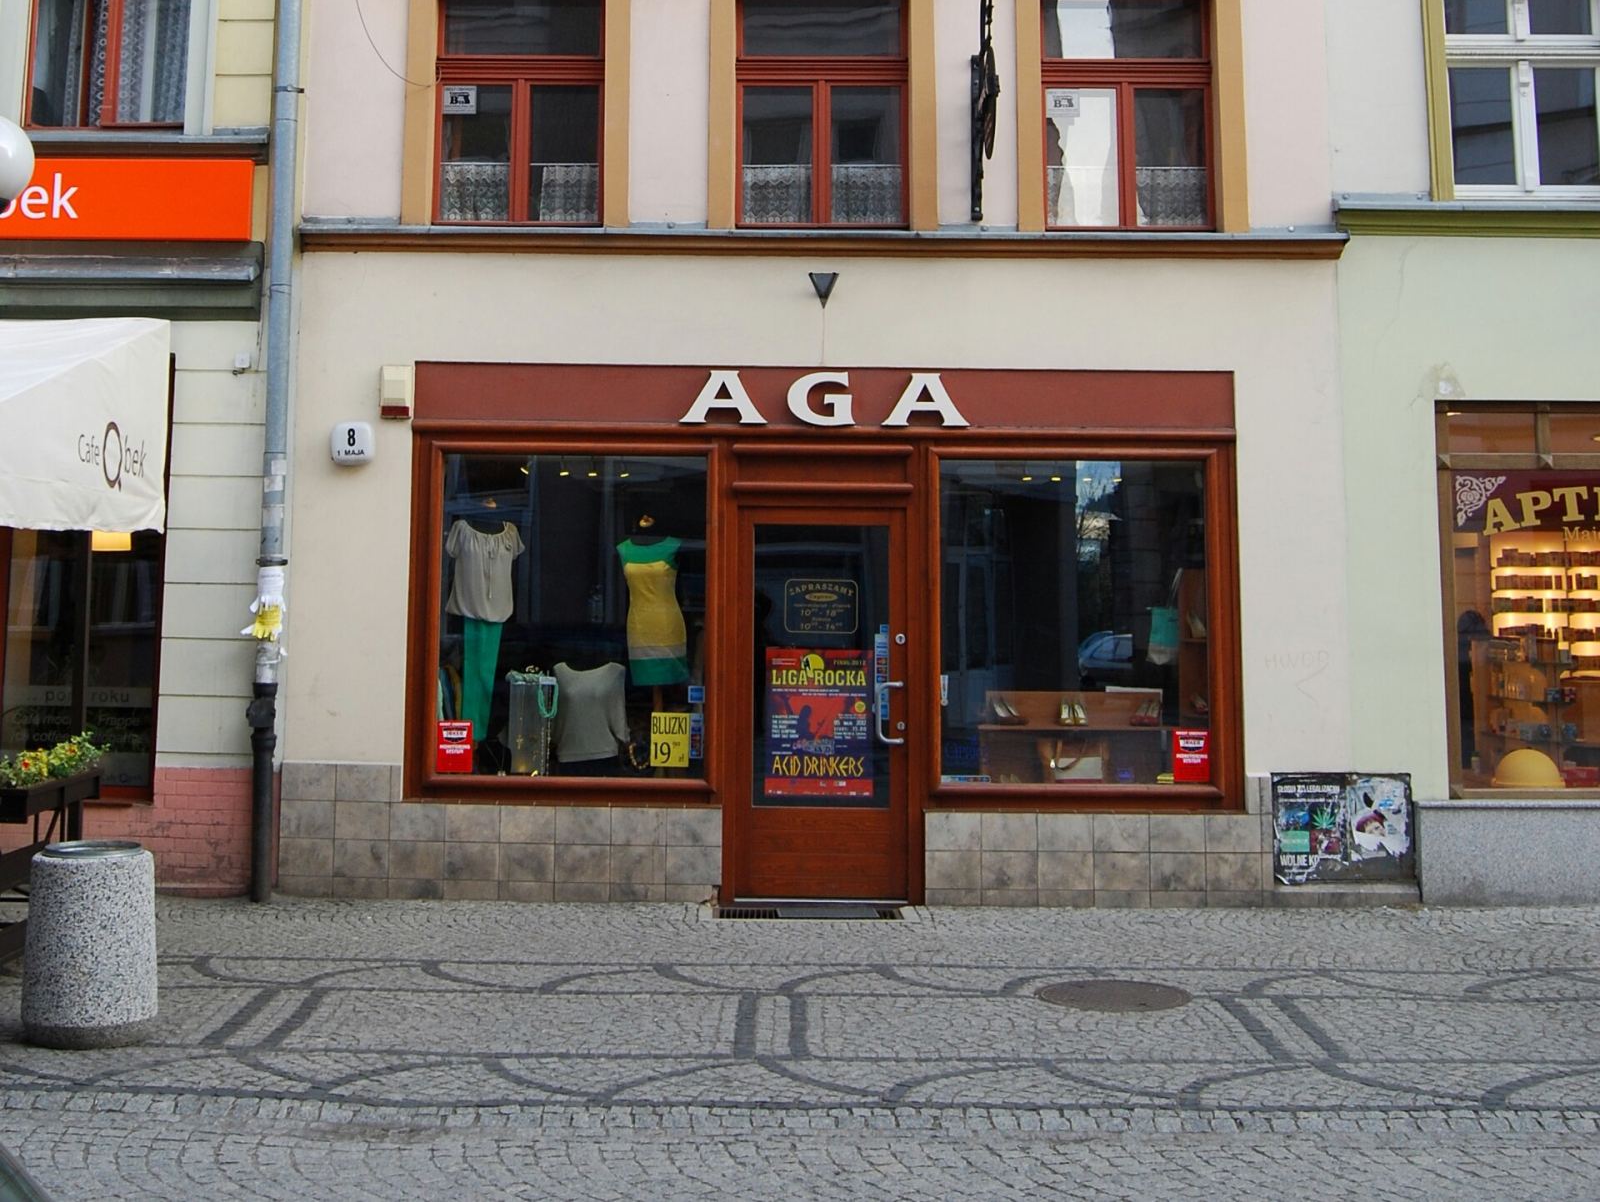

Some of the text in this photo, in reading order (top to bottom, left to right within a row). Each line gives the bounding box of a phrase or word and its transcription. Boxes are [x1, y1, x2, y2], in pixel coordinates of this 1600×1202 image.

[678, 369, 971, 427] AGA
[347, 428, 356, 447] 8
[78, 434, 100, 466] Cafe
[772, 669, 867, 686] LIGA ROCKA
[91, 689, 129, 703] roku
[652, 717, 687, 735] BLUZKI
[653, 741, 671, 764] 19
[772, 756, 864, 777] ACID DRINKERS
[1280, 854, 1308, 867] WOLNE
